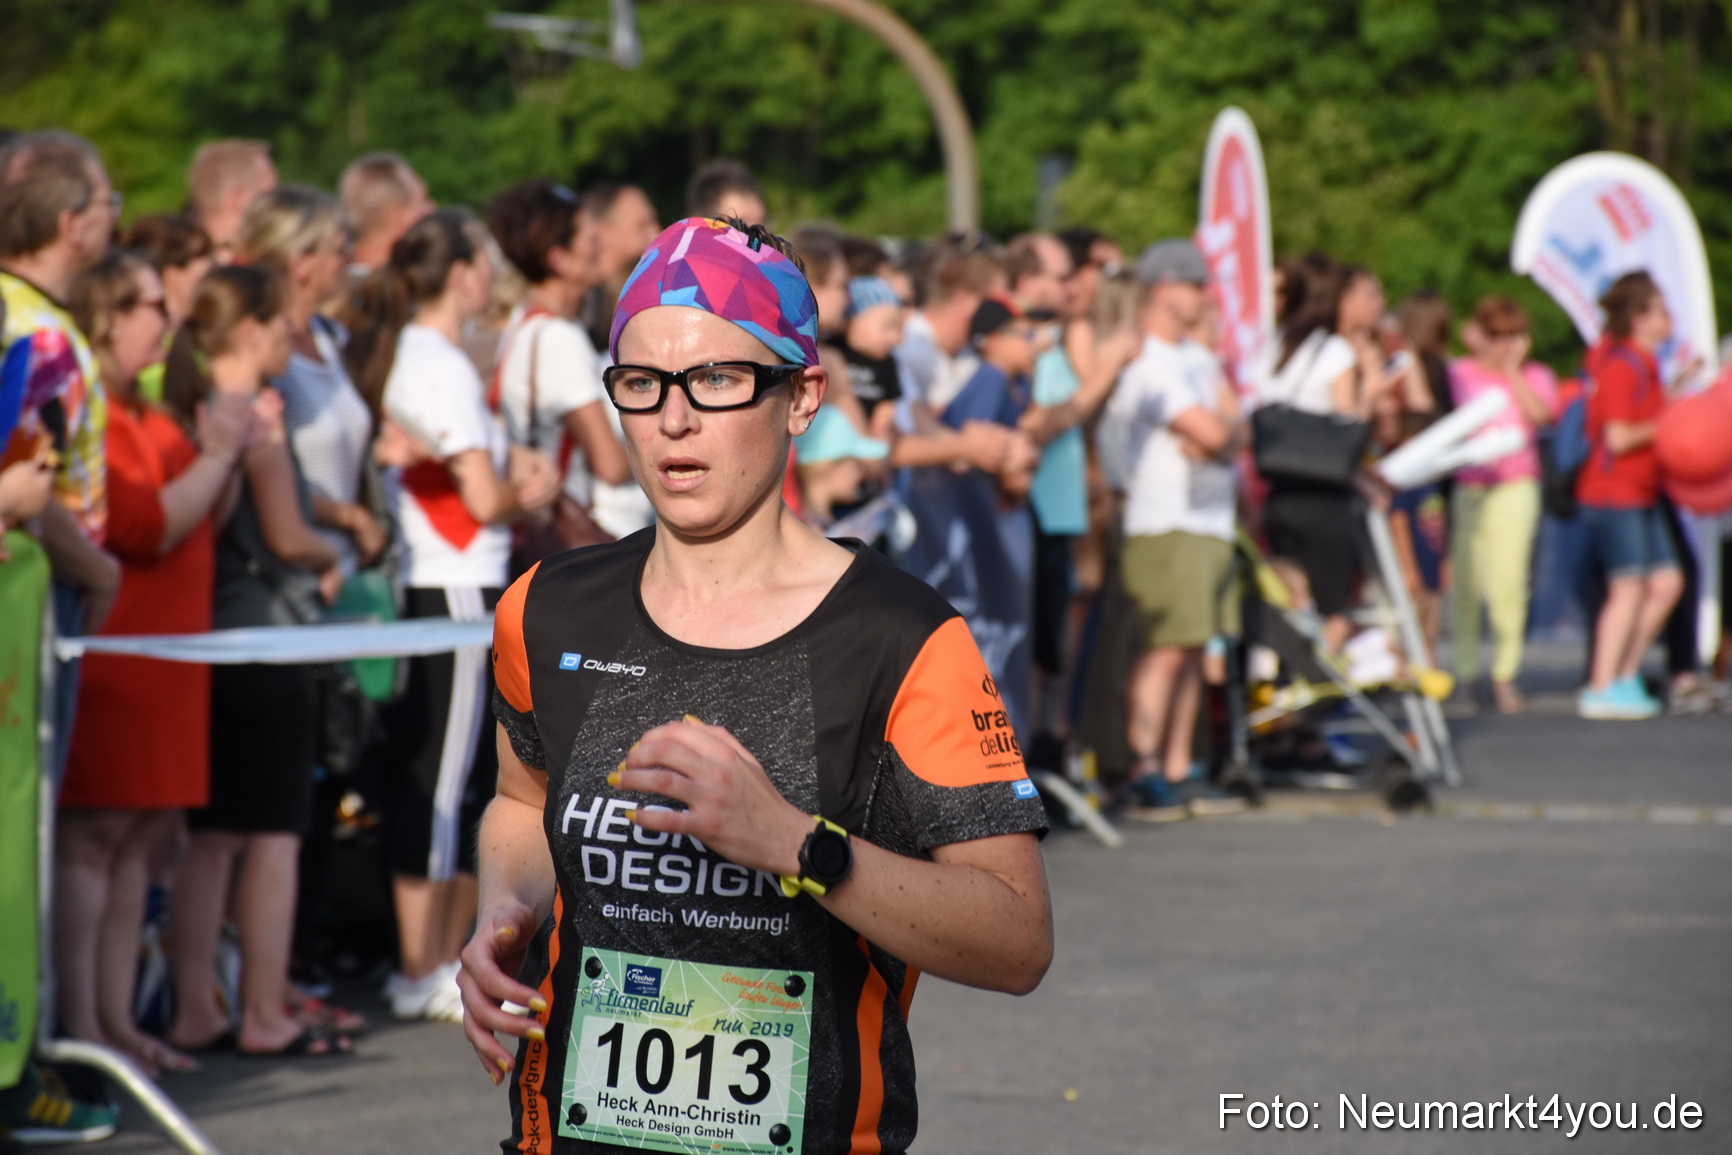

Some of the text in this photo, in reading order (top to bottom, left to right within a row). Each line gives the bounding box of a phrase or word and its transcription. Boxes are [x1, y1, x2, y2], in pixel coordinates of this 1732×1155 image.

[602, 902, 790, 936] einfach Werbung!
[605, 1007, 642, 1018] neumarkt
[607, 988, 695, 1017] firmenlauf
[749, 1021, 794, 1037] 2019
[597, 1022, 771, 1106] 1013
[597, 1091, 761, 1126] Heck Ann-Christin
[616, 1115, 645, 1130] Heck
[648, 1119, 692, 1137] Design
[694, 1125, 735, 1140] GmbH
